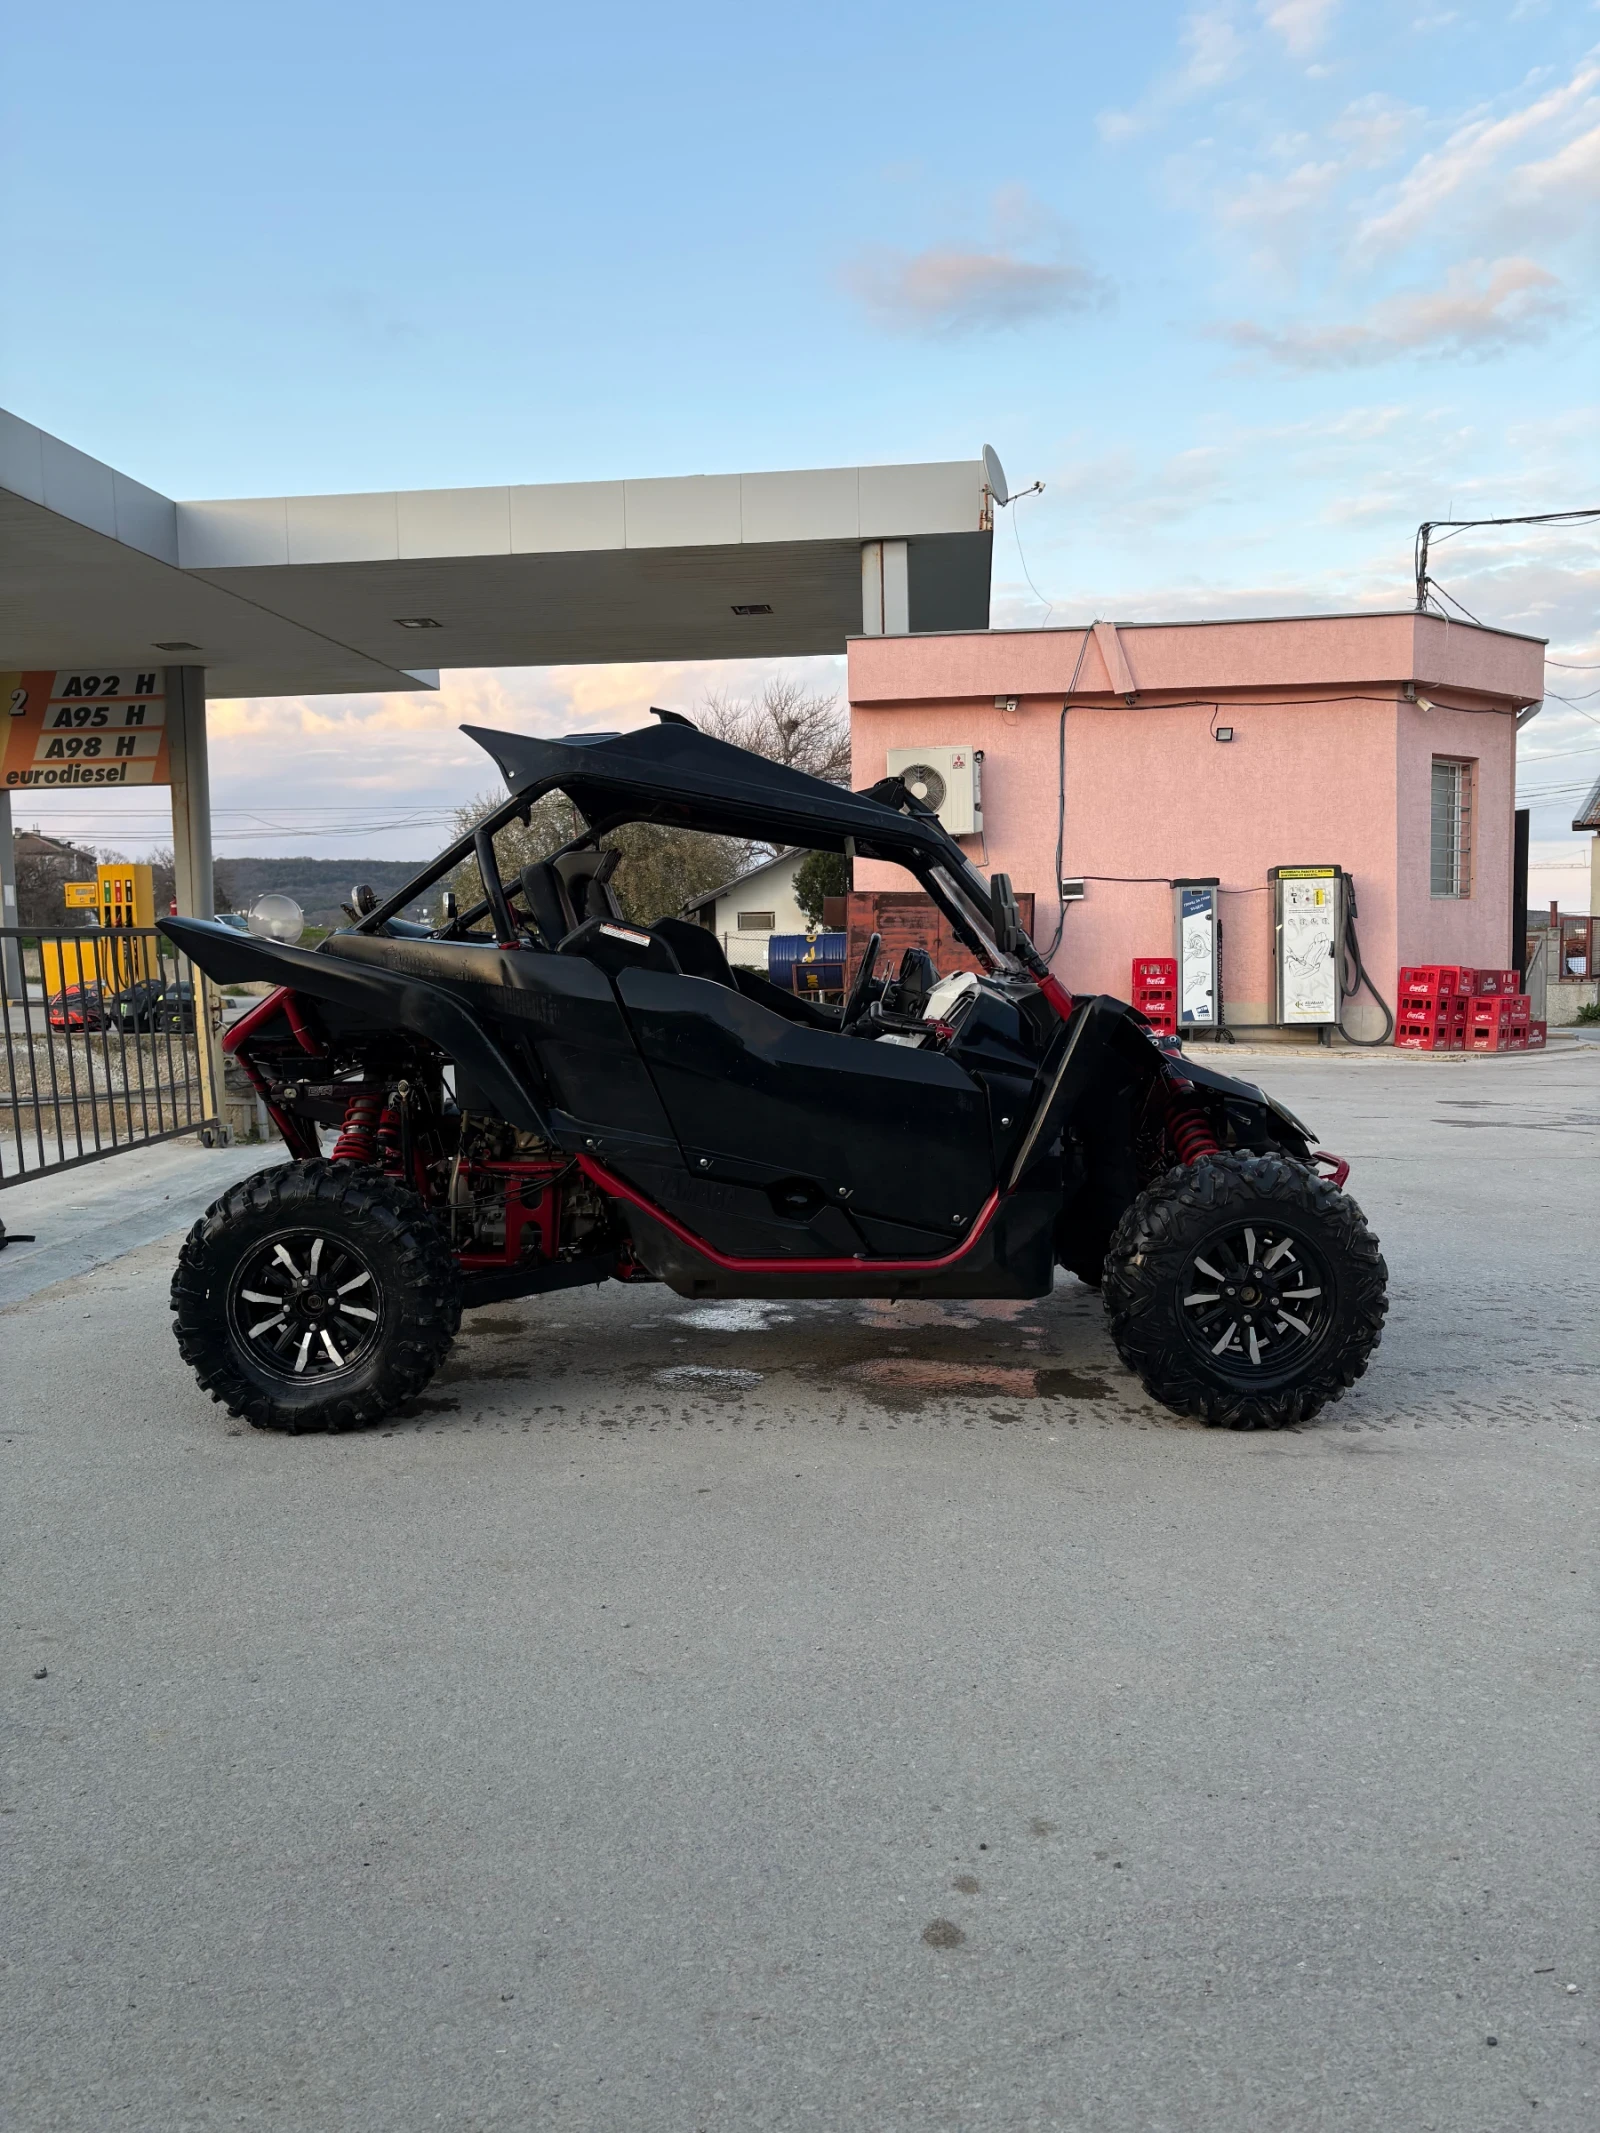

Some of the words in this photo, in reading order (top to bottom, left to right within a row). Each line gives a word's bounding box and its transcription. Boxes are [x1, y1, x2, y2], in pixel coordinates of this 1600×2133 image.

[62, 676, 120, 697] A92
[135, 673, 156, 694] H
[9, 688, 29, 716] 2
[52, 706, 109, 728] A95
[125, 704, 146, 725] H
[45, 737, 102, 758] A98
[115, 736, 136, 756] H
[6, 762, 127, 785] eurodiesel
